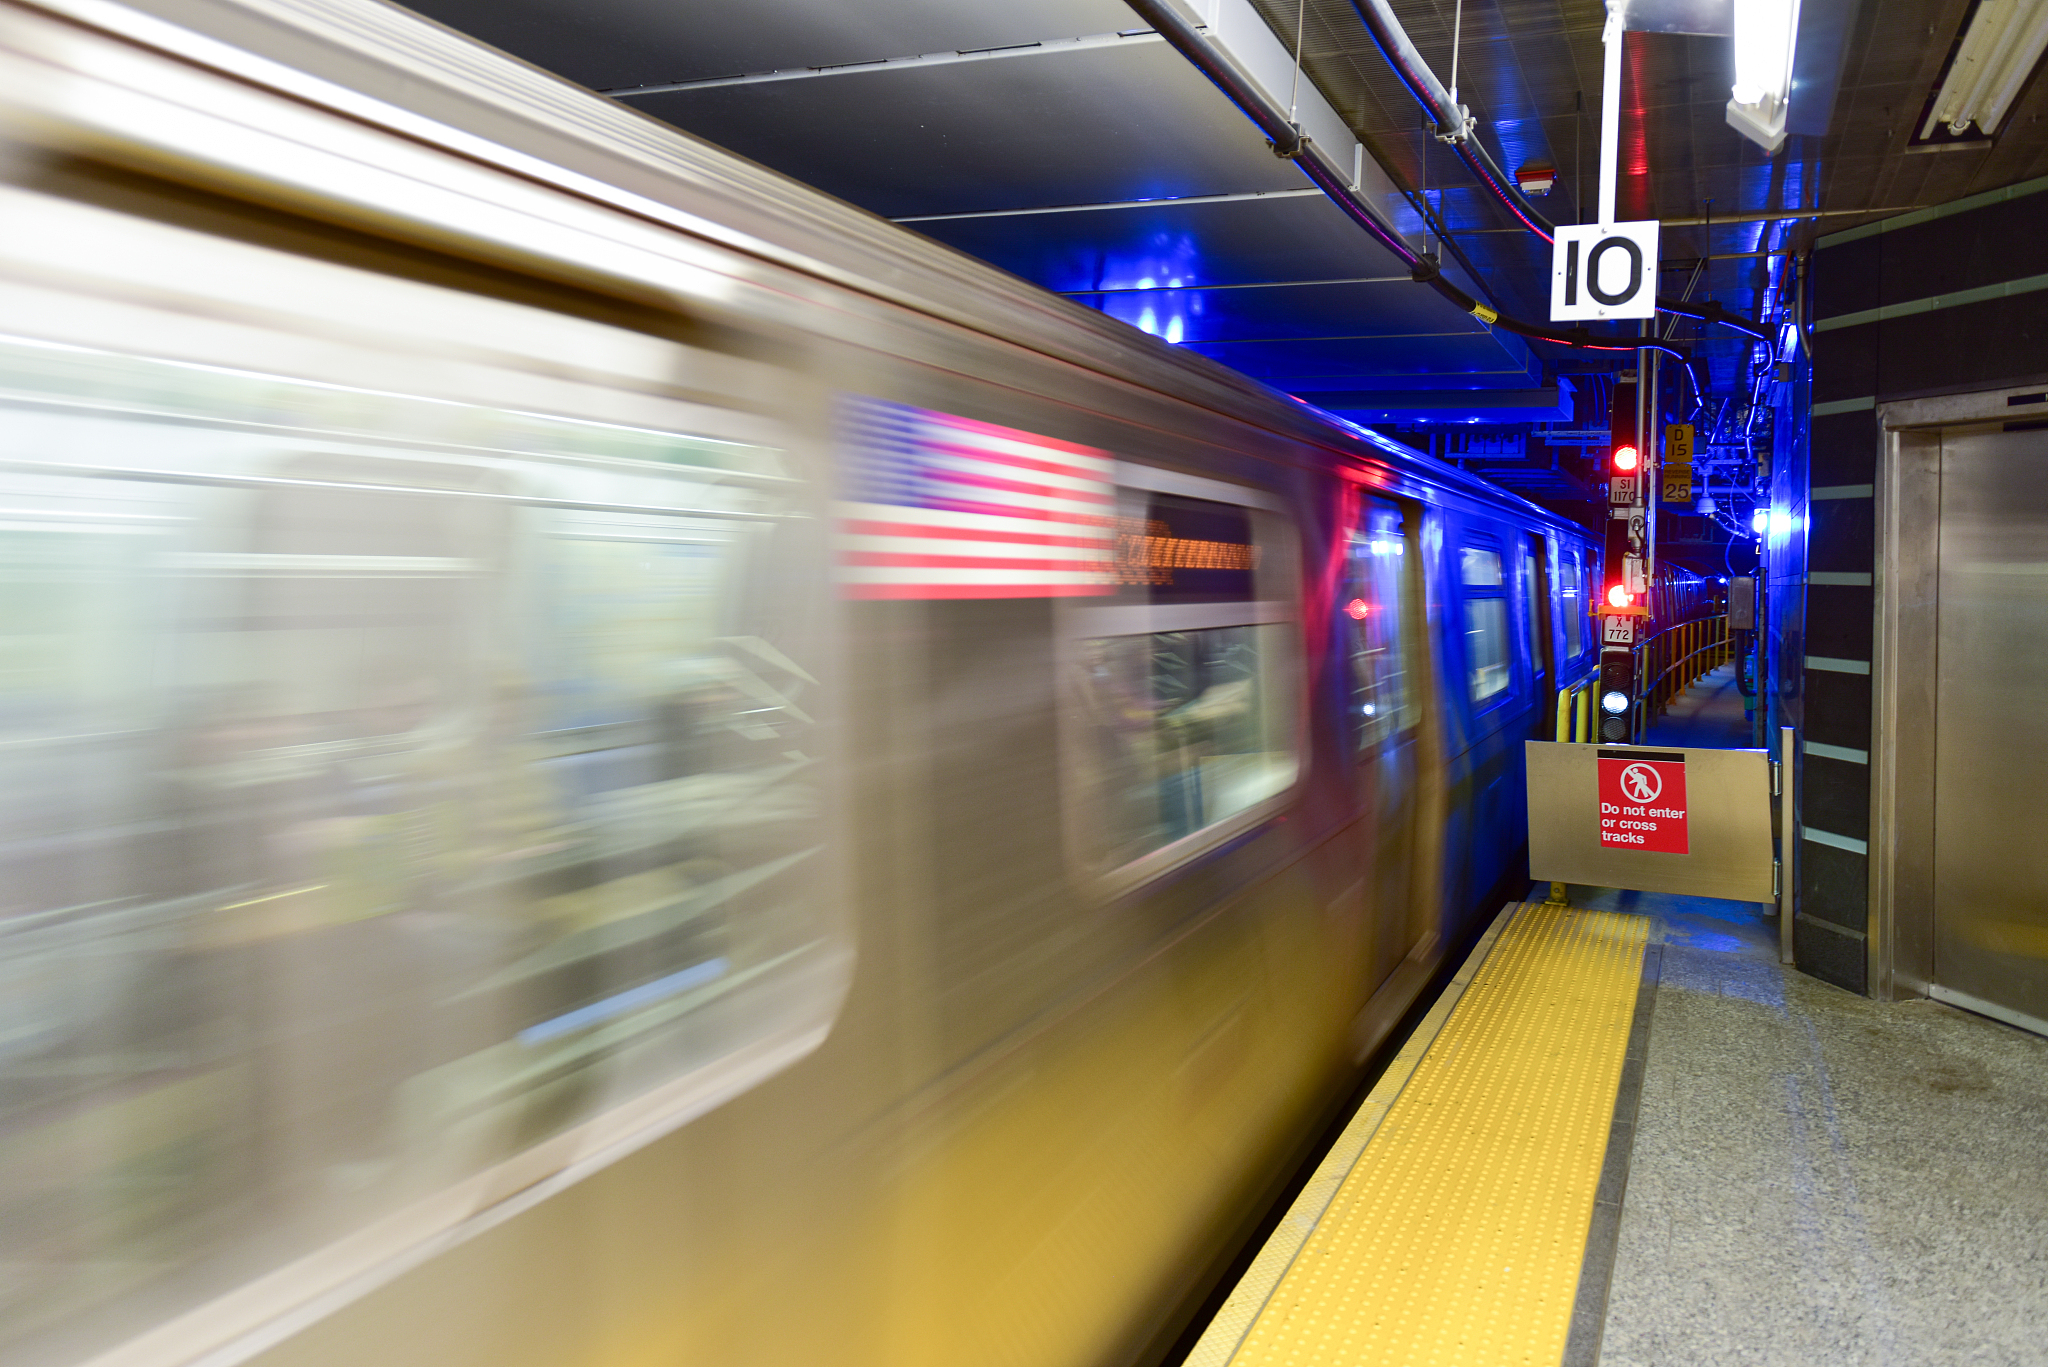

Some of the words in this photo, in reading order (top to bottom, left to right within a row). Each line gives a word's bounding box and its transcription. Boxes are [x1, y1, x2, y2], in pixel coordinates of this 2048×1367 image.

[1565, 236, 1642, 306] 10
[1674, 429, 1683, 441] D
[1671, 444, 1687, 456] 15
[1665, 483, 1689, 499] 25
[1616, 617, 1622, 627] X
[1609, 629, 1629, 640] 772
[1601, 802, 1620, 814] Do
[1623, 806, 1645, 817] not
[1648, 807, 1685, 819] enter
[1601, 818, 1616, 828] or
[1619, 819, 1657, 831] cross
[1601, 830, 1645, 844] tracks
